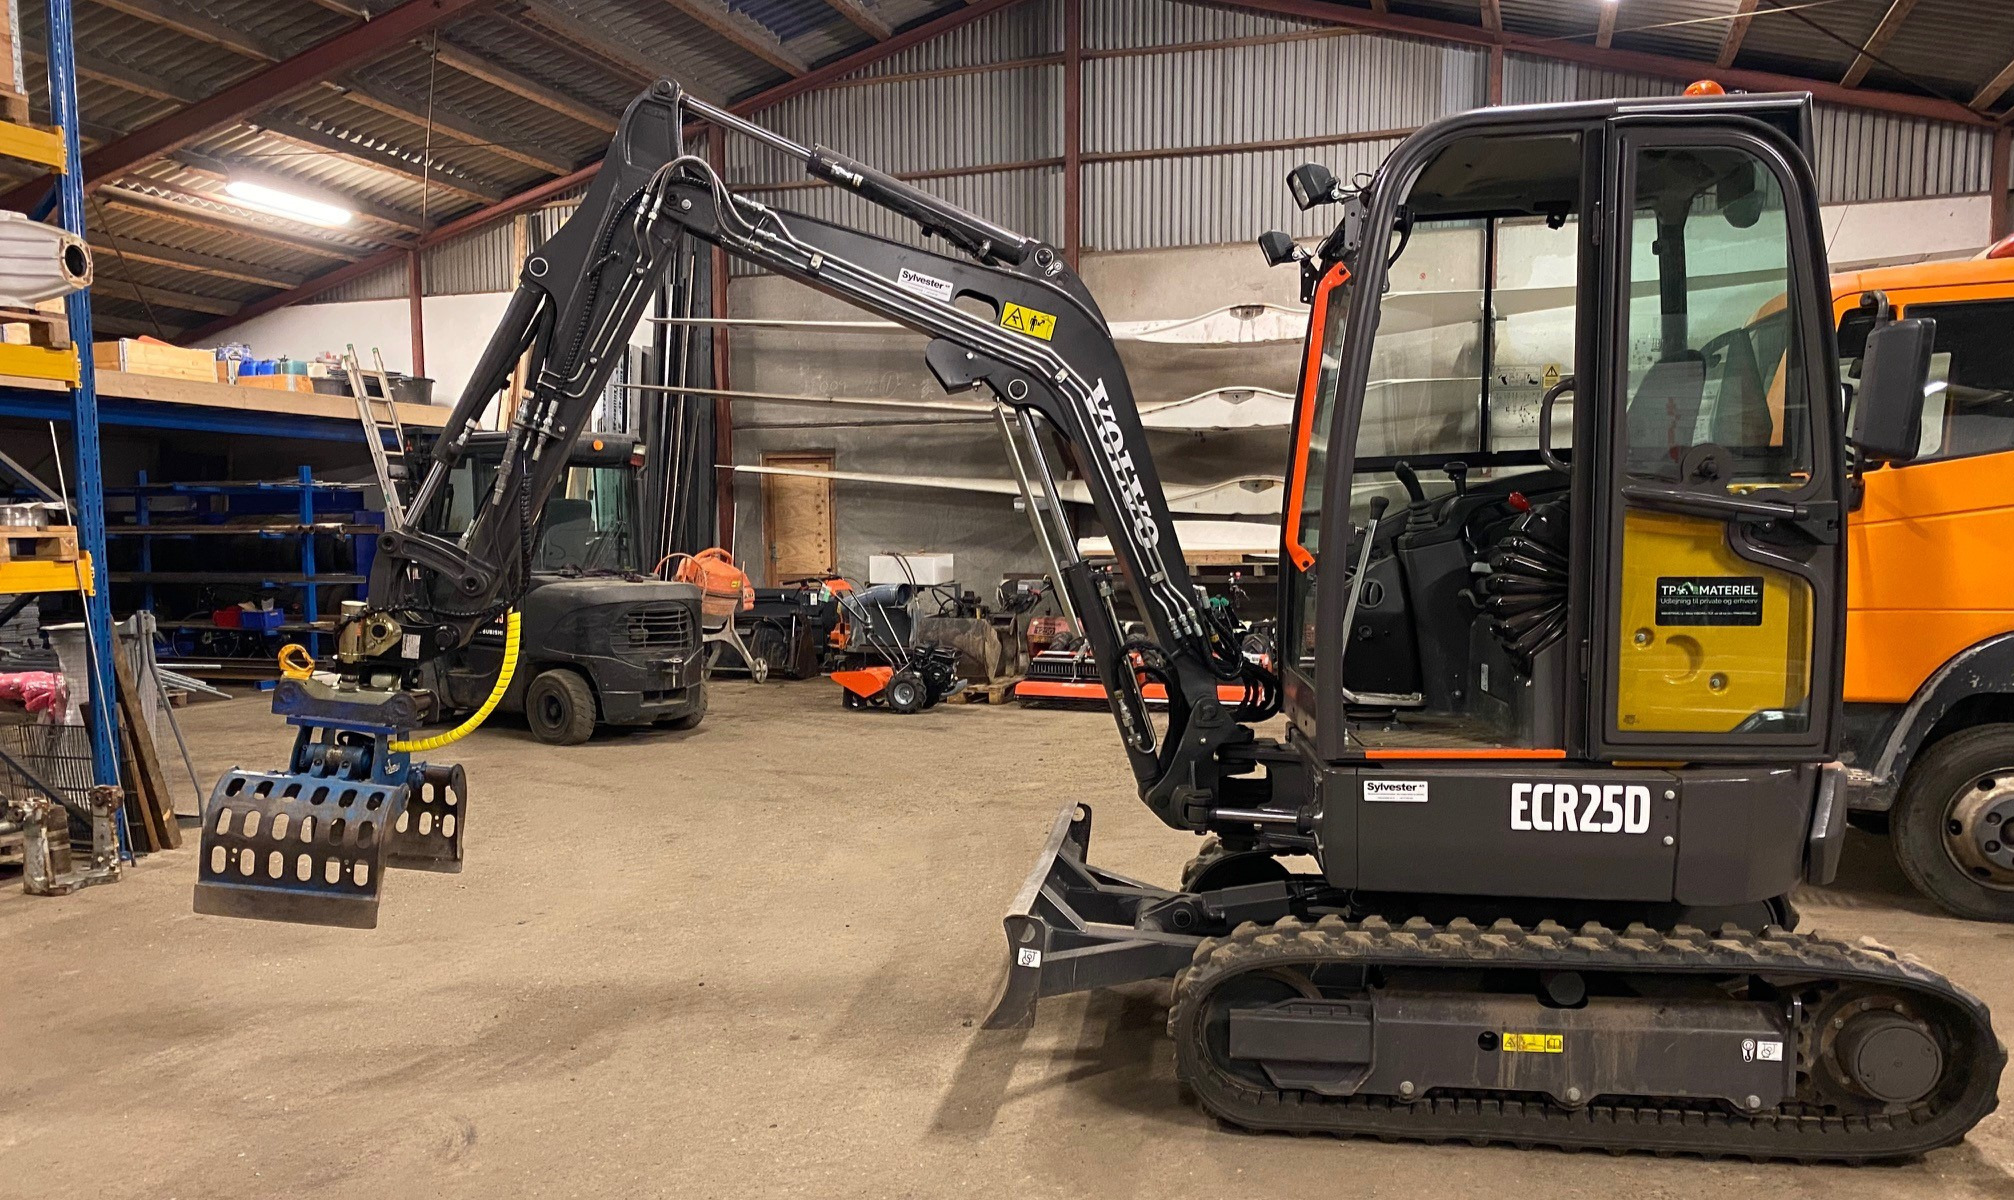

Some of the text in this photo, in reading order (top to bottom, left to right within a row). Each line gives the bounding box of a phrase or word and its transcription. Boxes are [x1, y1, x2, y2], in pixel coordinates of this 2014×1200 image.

[902, 270, 944, 289] Sylvester
[1086, 377, 1160, 549] VOLVO
[1661, 585, 1759, 596] TP MATERIEL
[1660, 597, 1691, 606] Udlejning
[1700, 597, 1722, 606] private
[1733, 597, 1758, 605] erhverv
[1367, 782, 1417, 793] Sylvester
[1511, 783, 1650, 834] ECR25D
